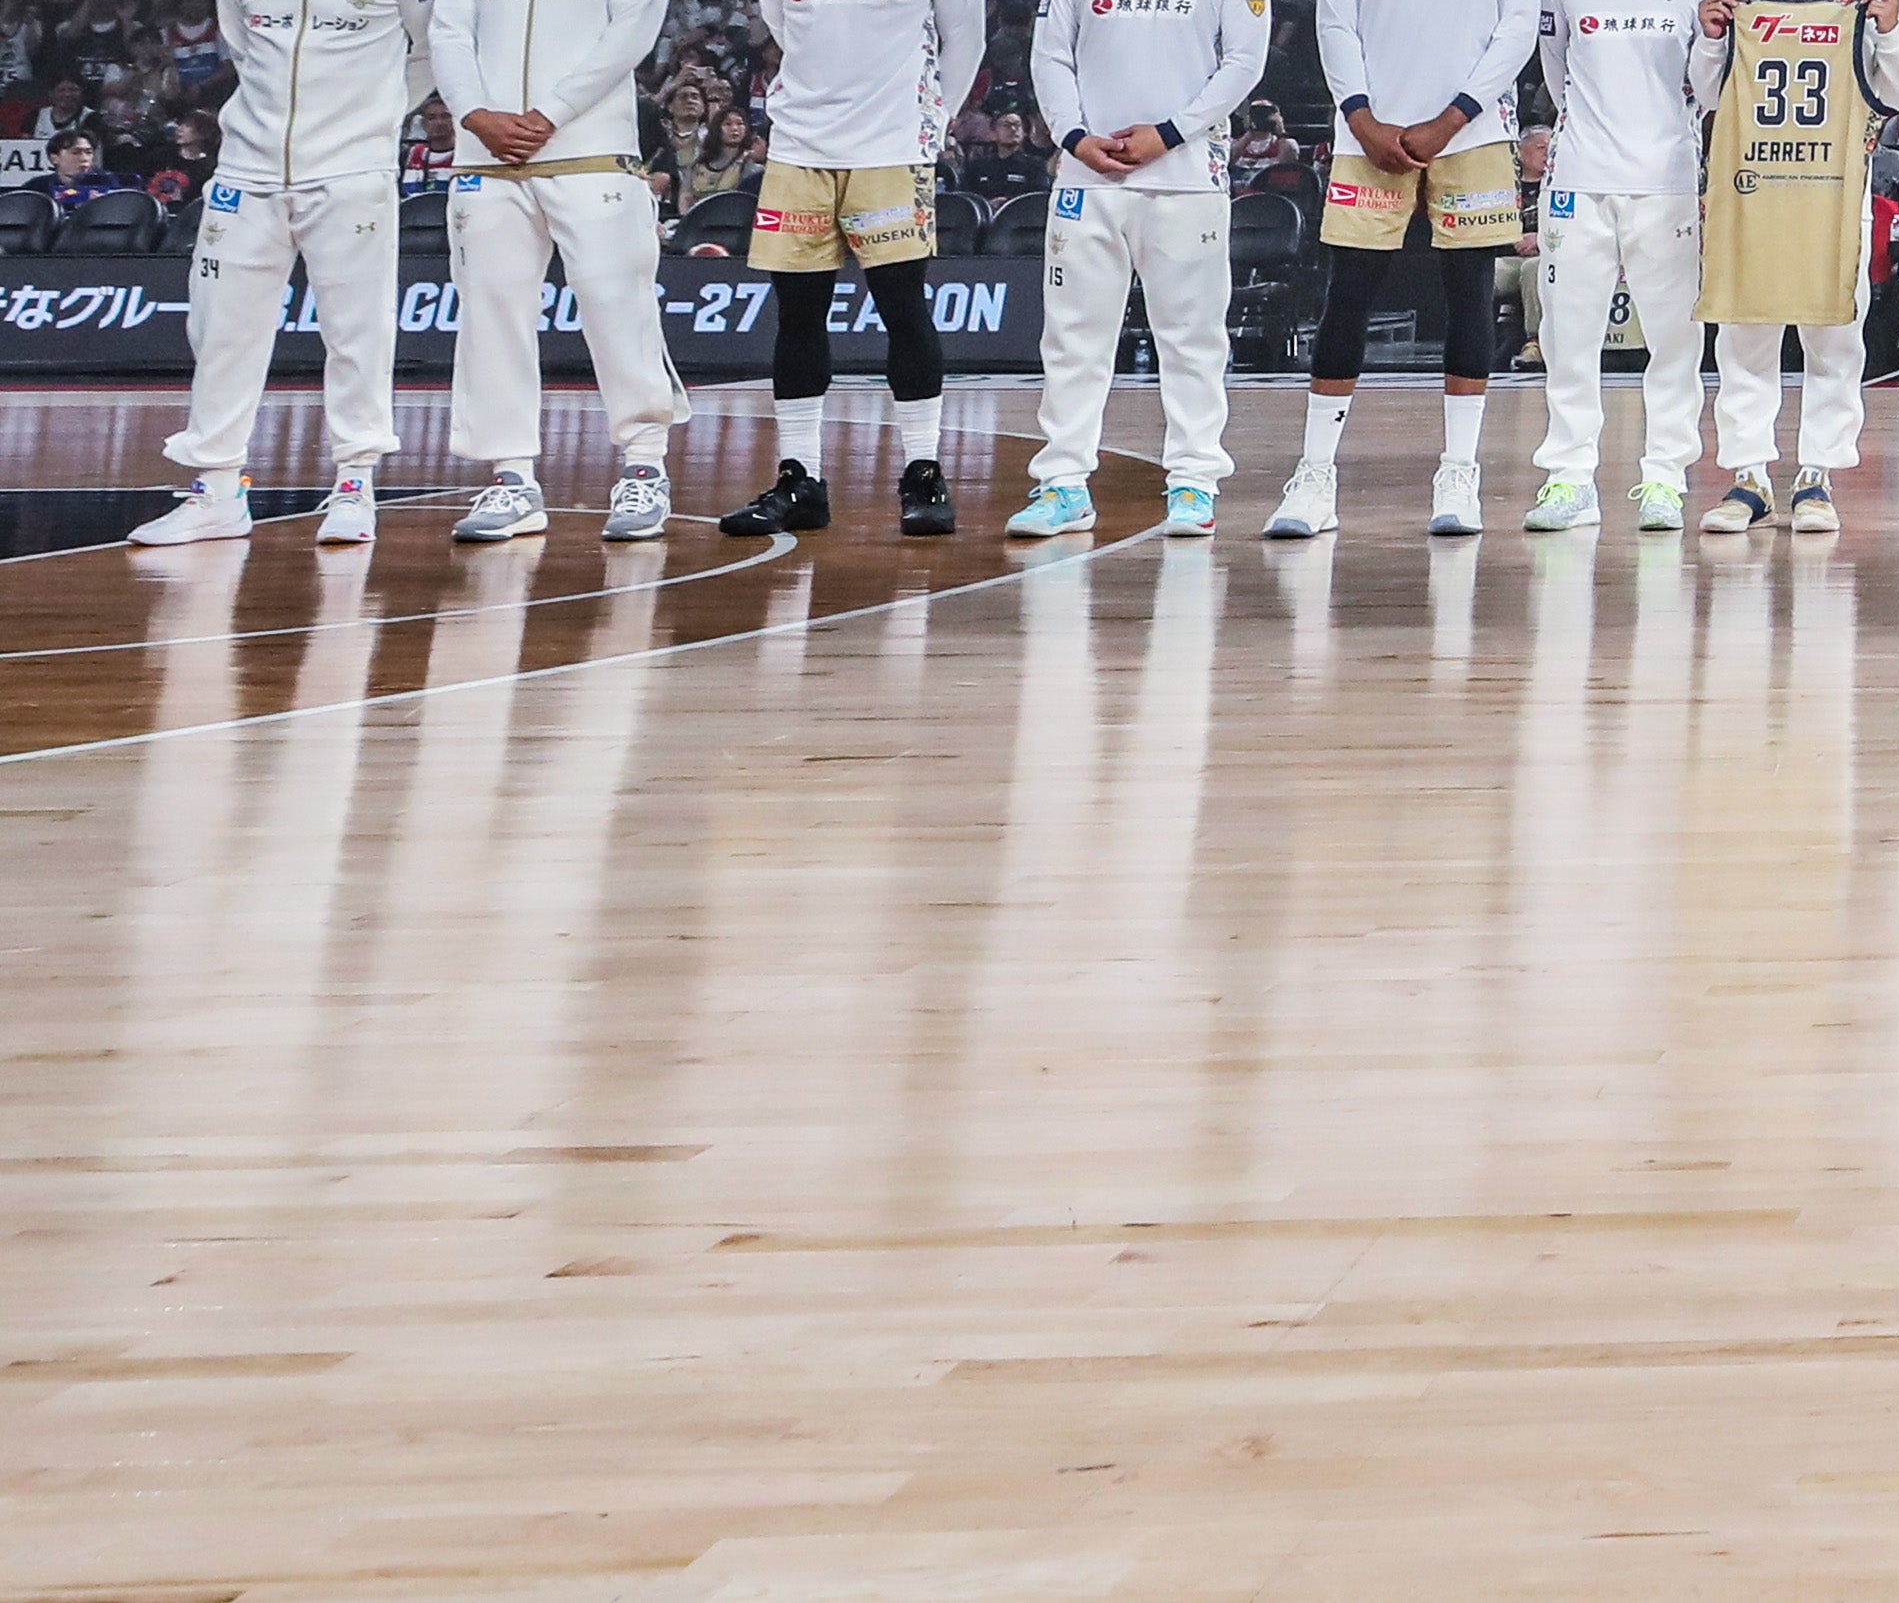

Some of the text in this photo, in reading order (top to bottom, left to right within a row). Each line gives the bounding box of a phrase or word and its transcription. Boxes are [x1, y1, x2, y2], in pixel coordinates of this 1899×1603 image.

[1602, 16, 1676, 33] 琉球銀行
[1754, 58, 1830, 128] 33
[1744, 142, 1832, 162] JERRETT
[1458, 212, 1518, 227] RYUSEKI
[200, 258, 220, 279] 34
[1048, 265, 1063, 287] 15
[1547, 264, 1556, 284] 3
[826, 283, 1007, 332] EAON
[1605, 333, 1624, 344] AKI
